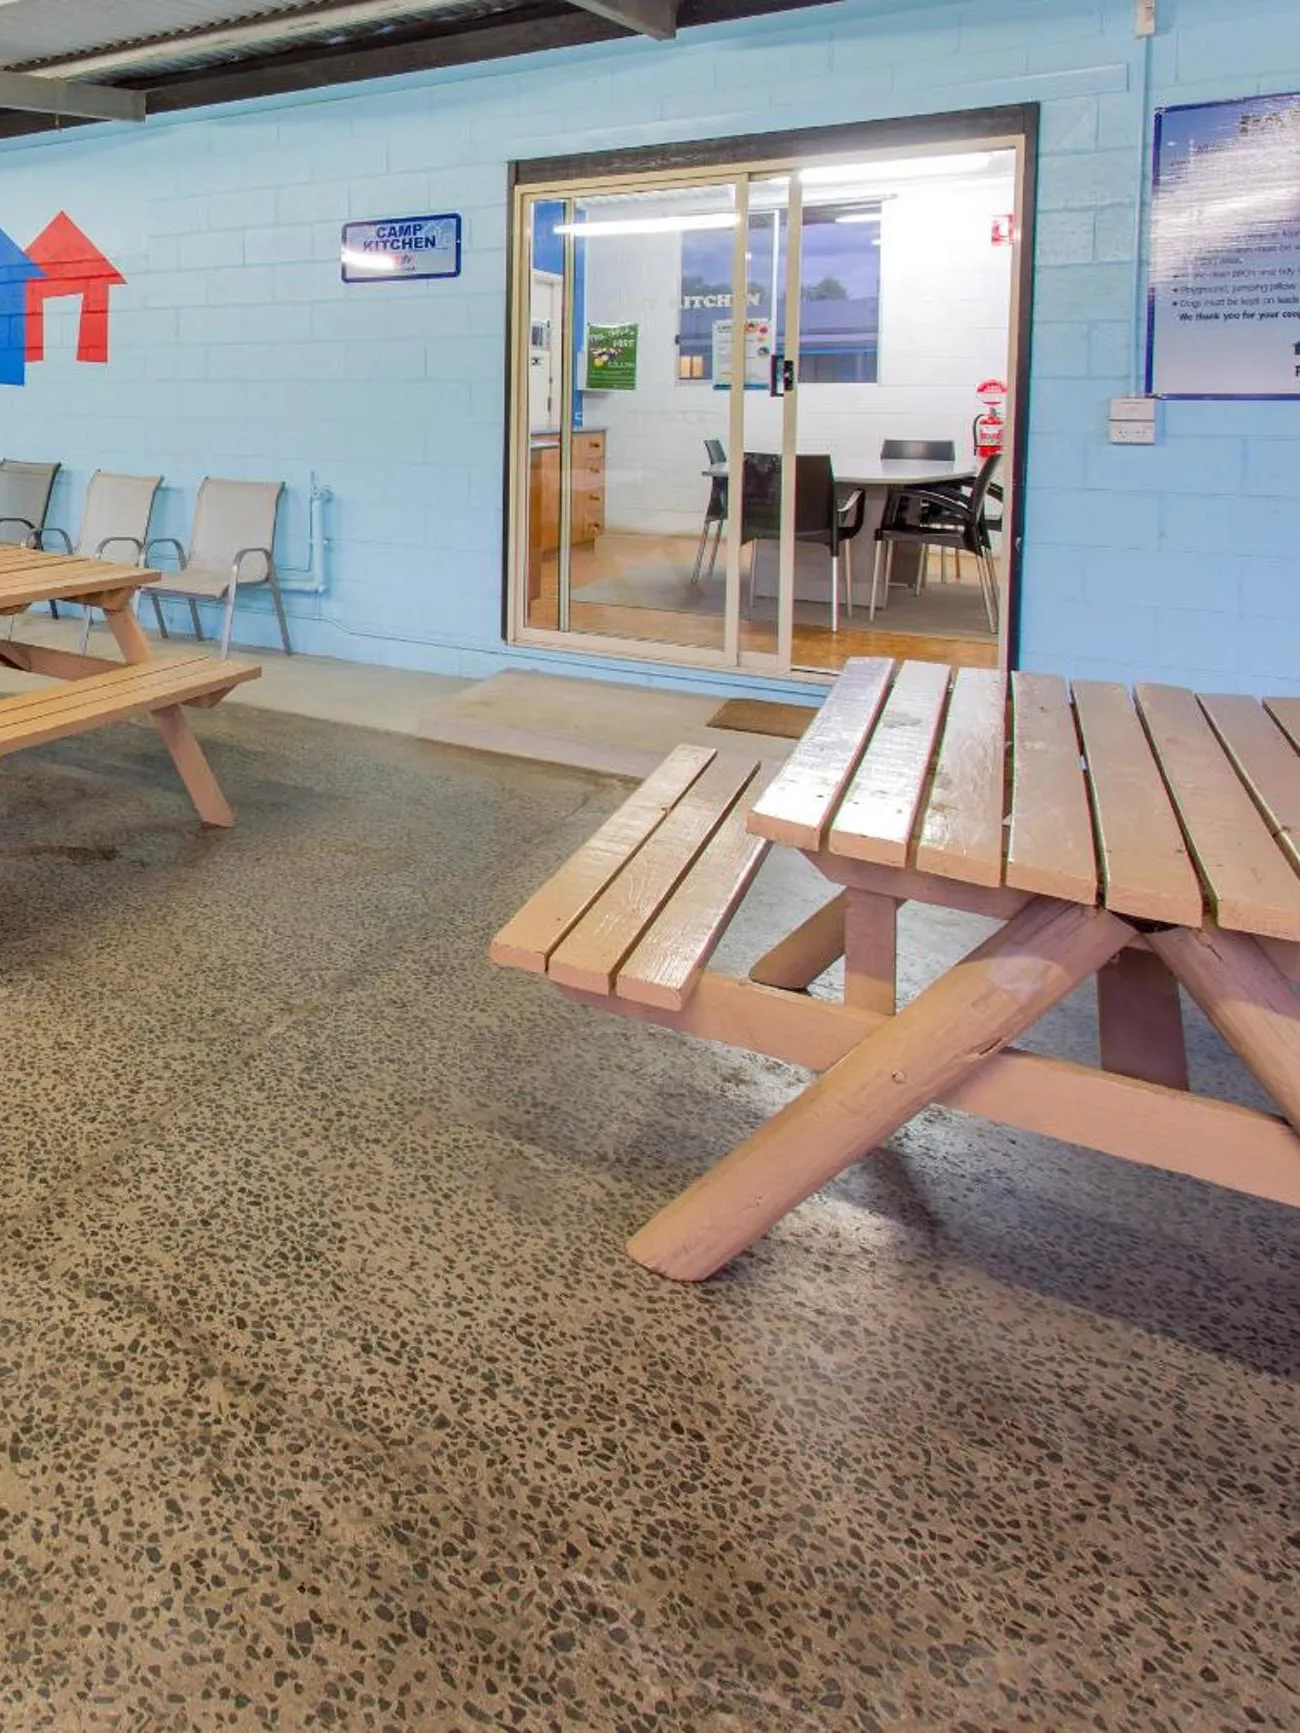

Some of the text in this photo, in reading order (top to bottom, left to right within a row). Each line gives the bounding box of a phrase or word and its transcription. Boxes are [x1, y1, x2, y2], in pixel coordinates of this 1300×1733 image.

[376, 224, 422, 238] CAMP
[364, 236, 436, 252] KITCHEN
[676, 293, 760, 310] ITCHN
[1204, 298, 1225, 306] must
[1227, 297, 1237, 306] be
[1241, 296, 1259, 306] kept
[1263, 297, 1275, 305] on
[1179, 312, 1192, 321] We
[1195, 311, 1219, 320] thank
[1223, 312, 1240, 322] you
[1242, 310, 1255, 319] for
[1259, 312, 1279, 321] your
